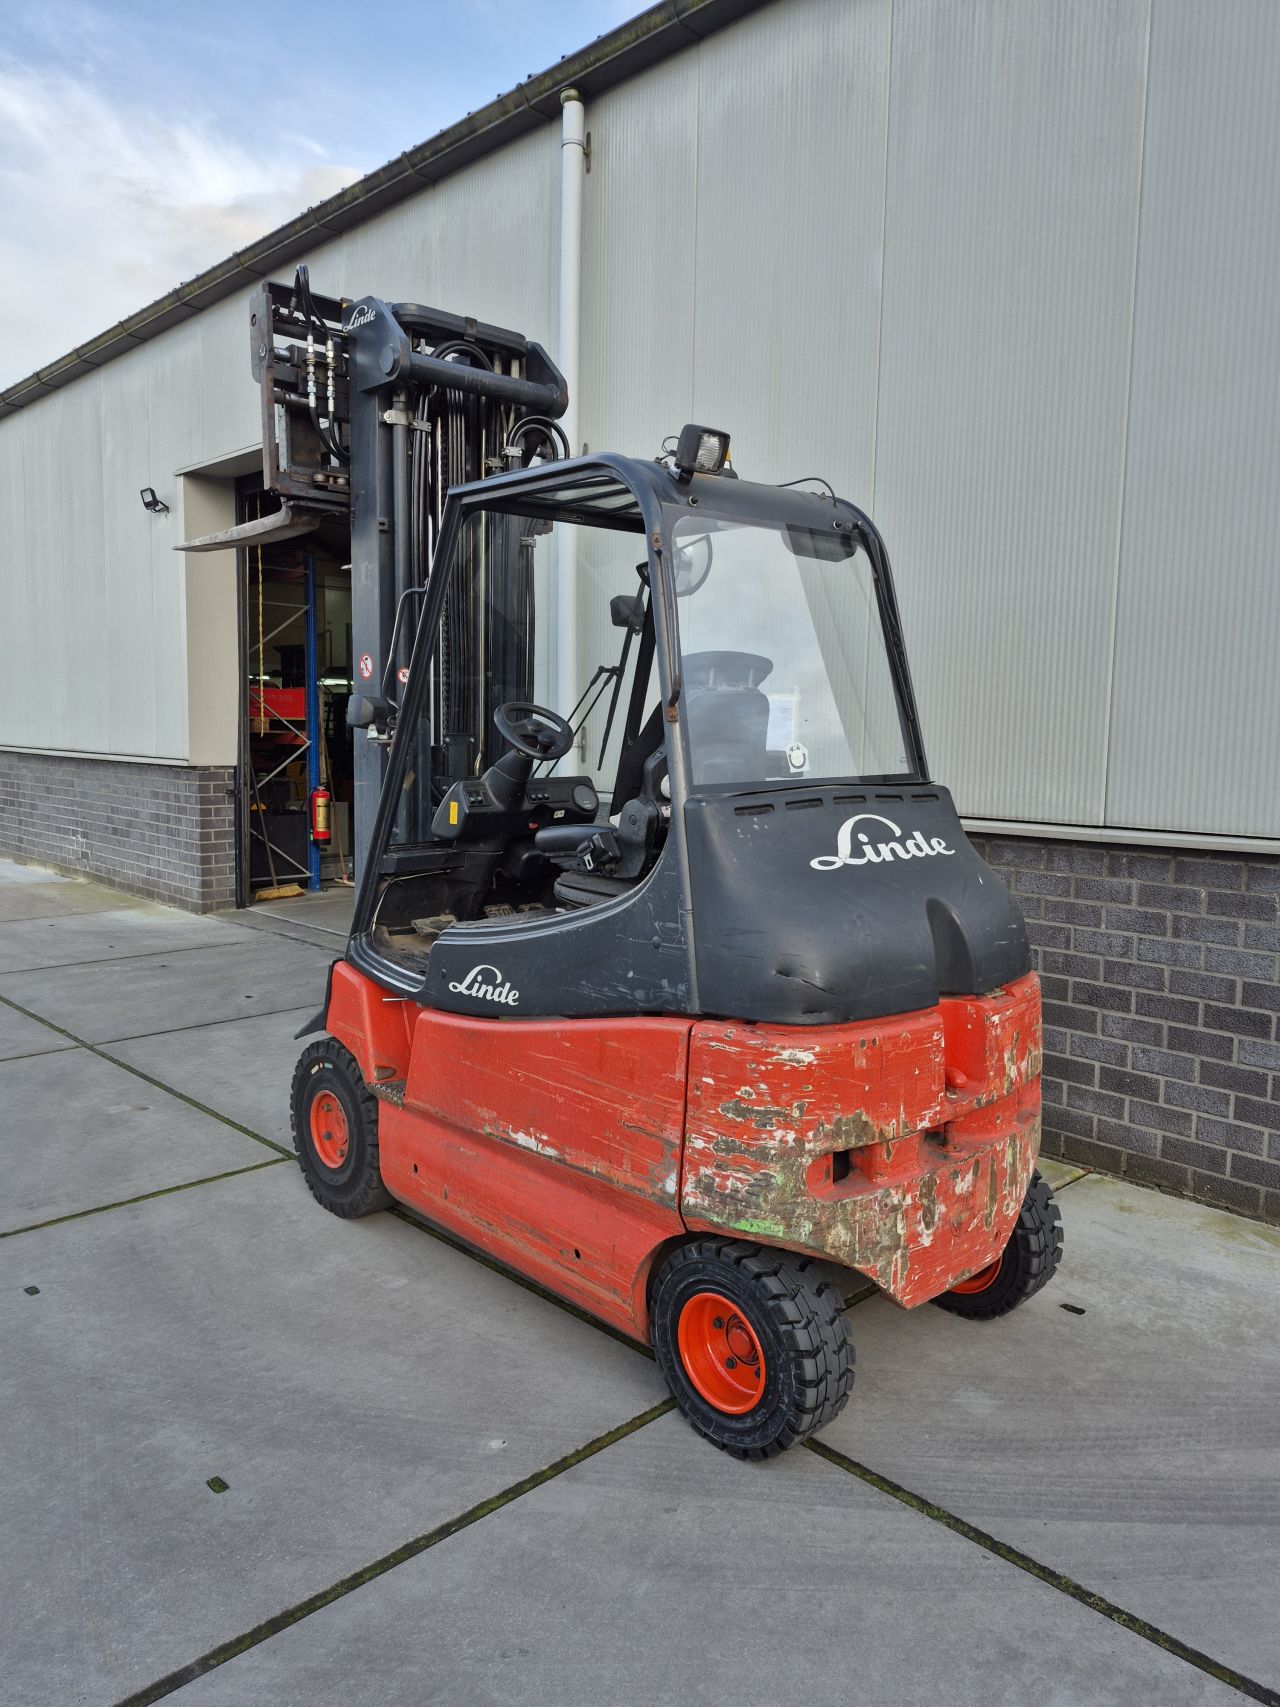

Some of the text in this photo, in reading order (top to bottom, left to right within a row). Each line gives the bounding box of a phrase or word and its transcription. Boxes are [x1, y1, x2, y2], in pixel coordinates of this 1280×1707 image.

[343, 305, 376, 332] Linde
[810, 814, 956, 870] Linde
[448, 964, 519, 1005] Linde
